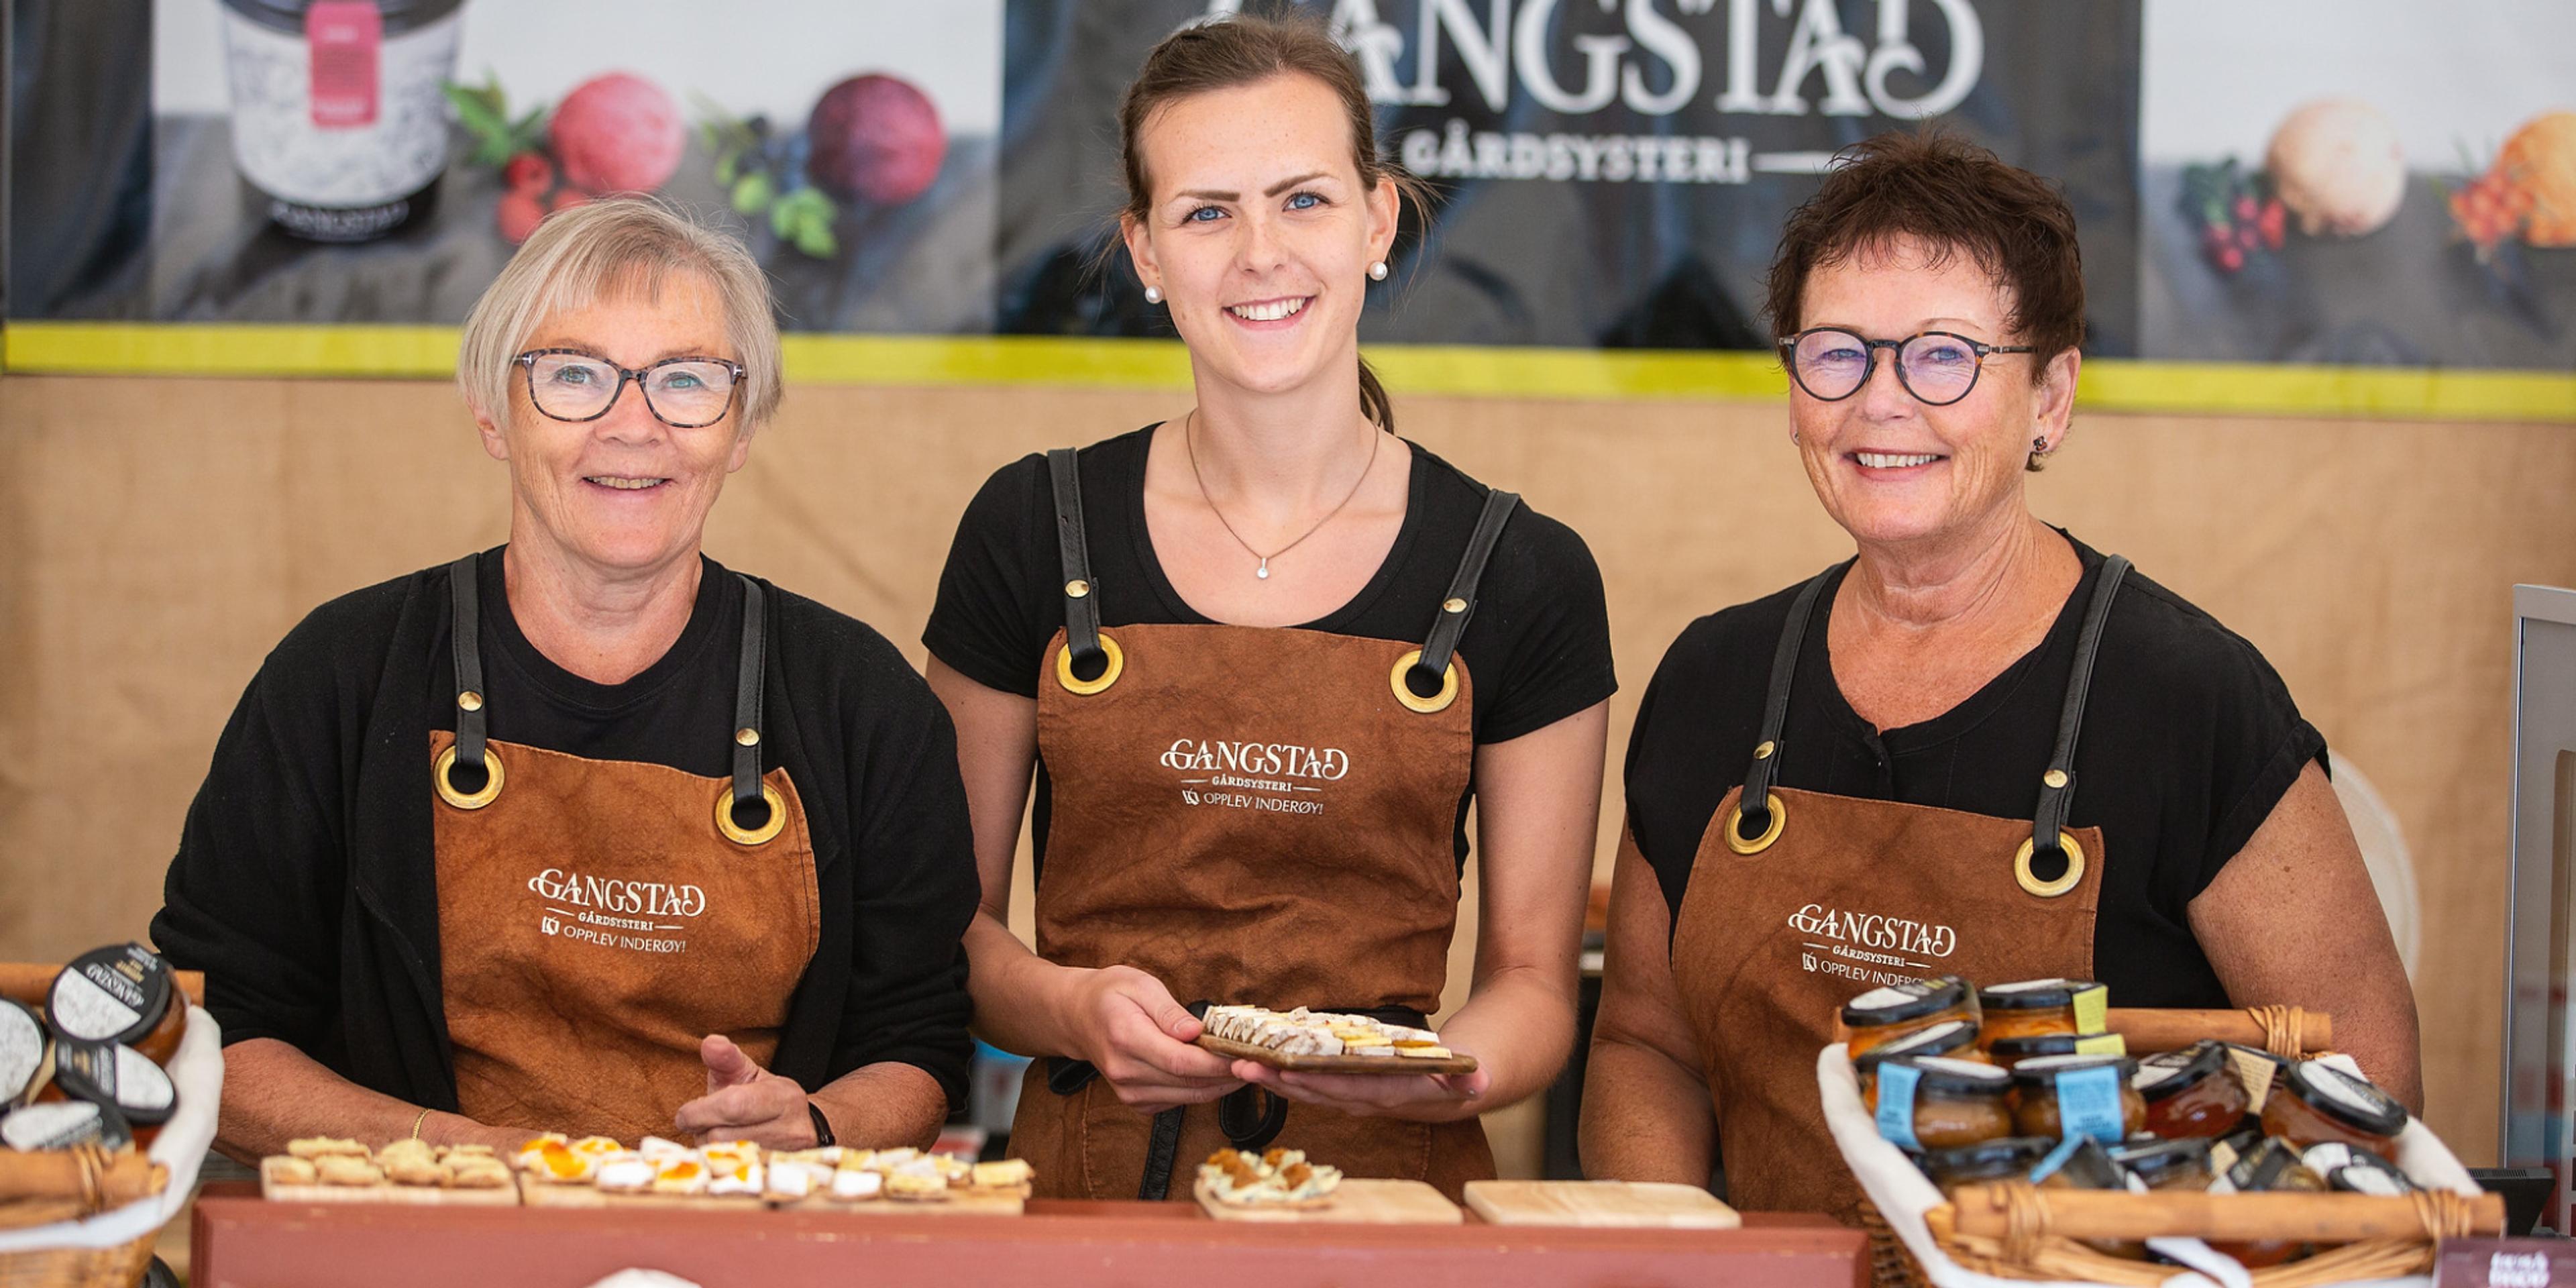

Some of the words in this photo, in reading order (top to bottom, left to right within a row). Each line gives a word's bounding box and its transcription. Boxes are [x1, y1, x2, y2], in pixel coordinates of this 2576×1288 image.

[1171, 0, 1984, 119] ANGSTAD
[1401, 118, 1750, 184] GÅRDSYSTERI
[1161, 739, 1349, 780] GANGSTAD
[1212, 773, 1292, 792] GÅRDSYSTERI
[1203, 792, 1253, 809] OPPLEV
[1255, 797, 1324, 815] INDERØY!
[528, 868, 706, 917] GANGSTAD
[578, 910, 655, 931] GÅRDSYSTERI
[1788, 904, 1957, 957] GANGSTAD
[564, 926, 618, 947] OPPLEV
[621, 938, 686, 953] INDERØY!
[1833, 945, 1905, 967] GÅRDSYSTERI
[1821, 961, 1870, 981] OPPLEV
